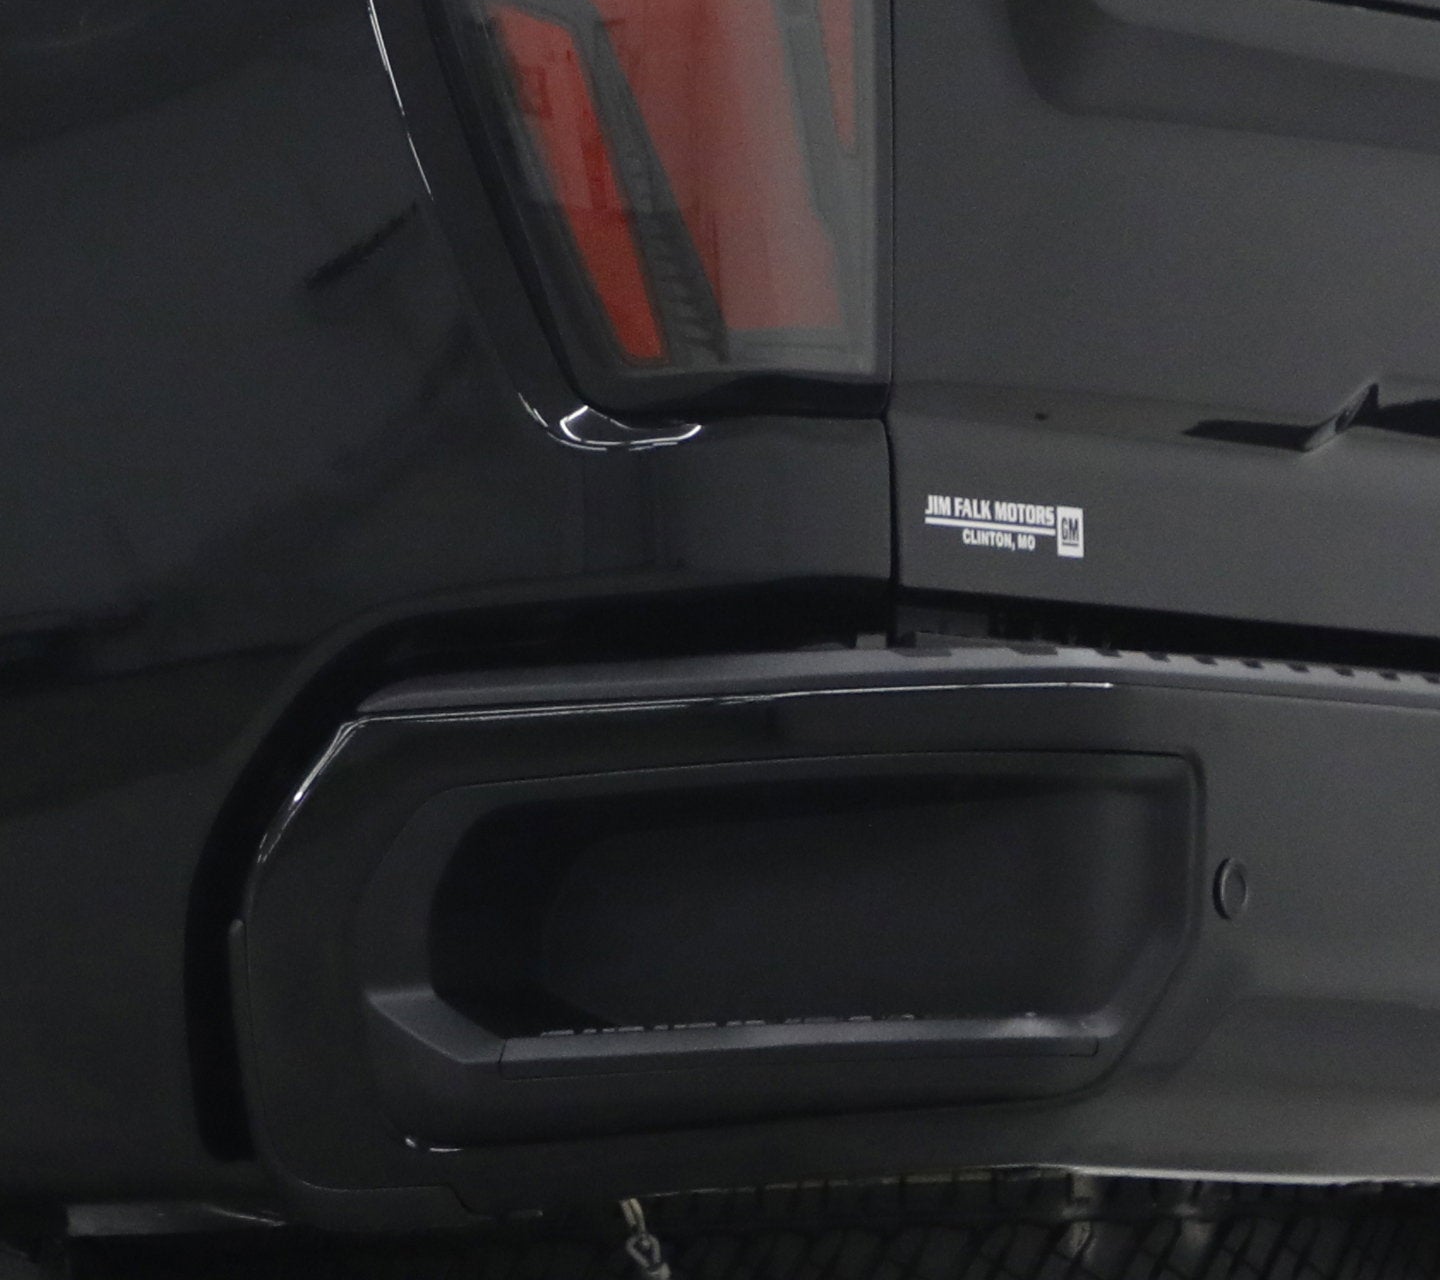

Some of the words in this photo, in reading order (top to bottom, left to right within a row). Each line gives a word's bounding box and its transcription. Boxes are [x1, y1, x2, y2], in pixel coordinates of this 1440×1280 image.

[924, 494, 951, 516] JIM
[954, 497, 992, 520] FALK
[994, 500, 1056, 526] MOTORS
[962, 528, 1016, 552] CLINTON,
[1017, 534, 1036, 551] MO
[1061, 517, 1080, 543] GM
